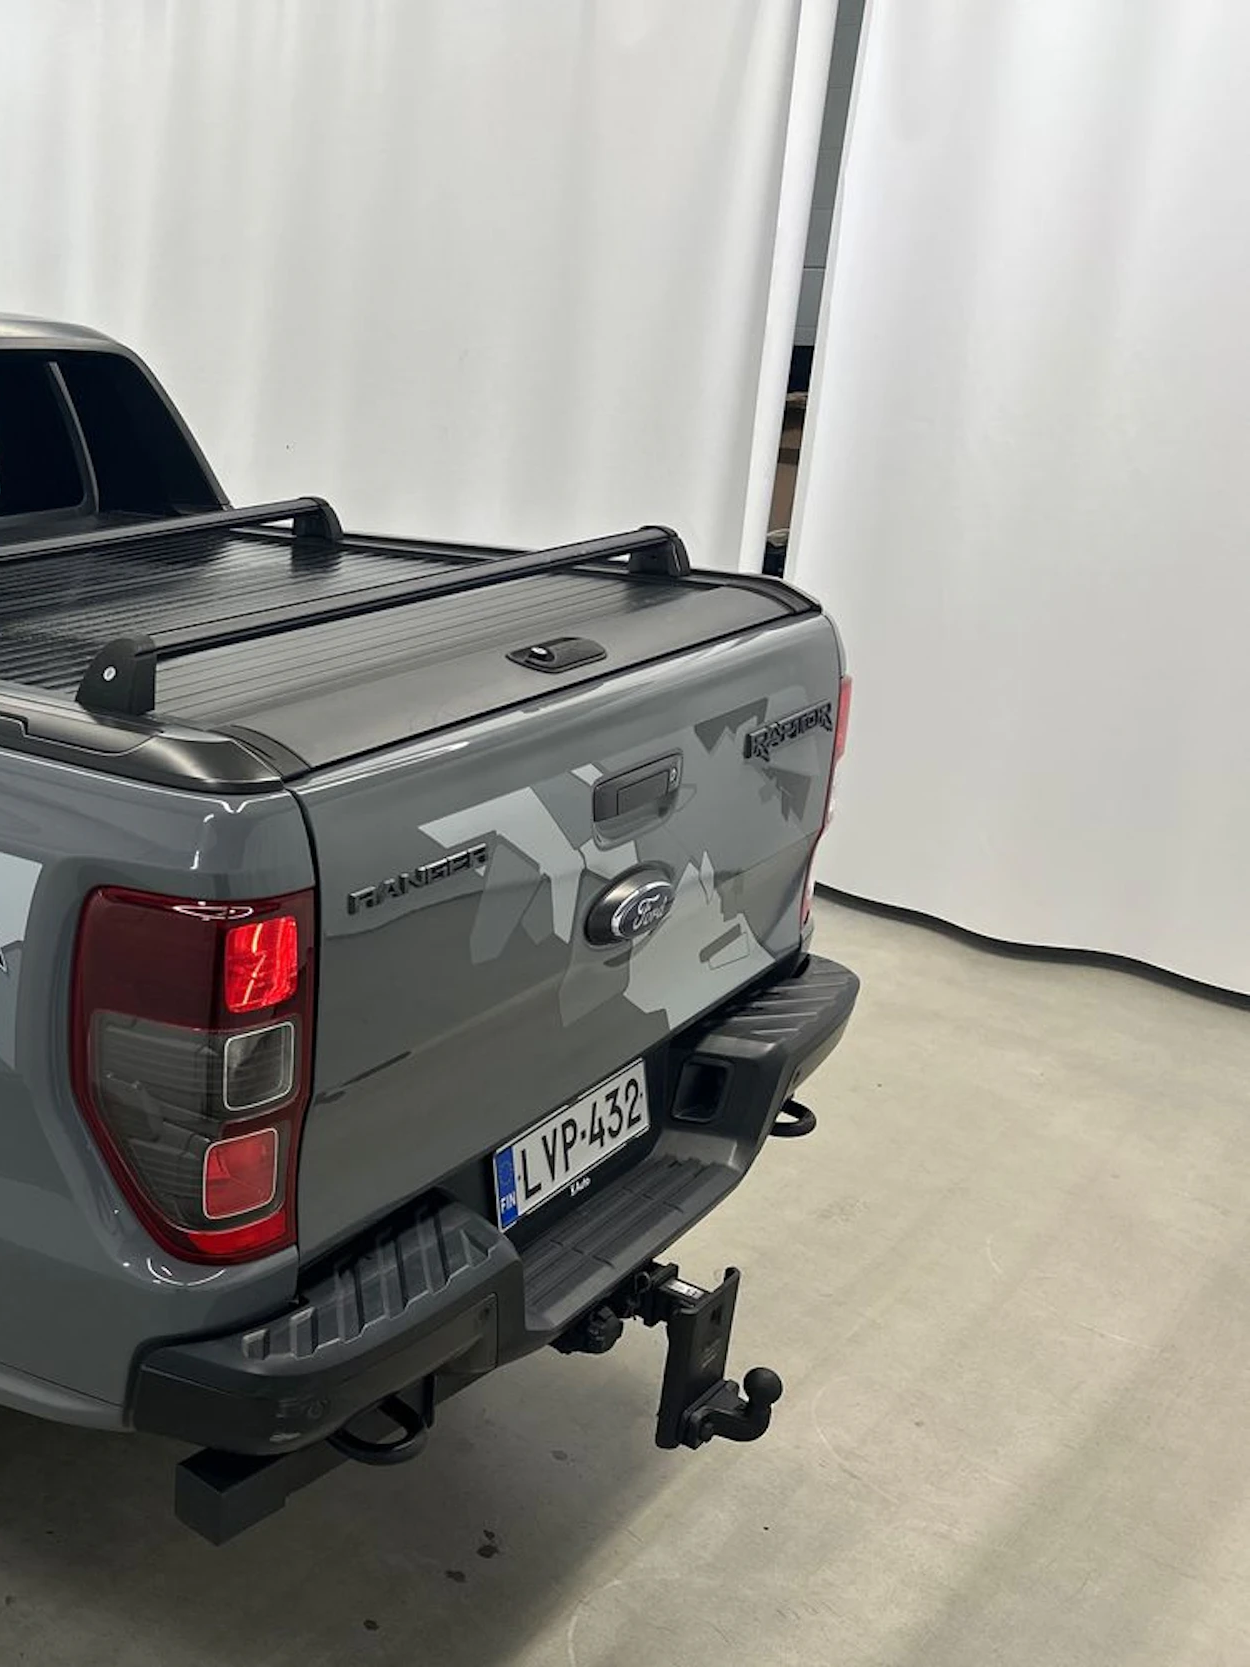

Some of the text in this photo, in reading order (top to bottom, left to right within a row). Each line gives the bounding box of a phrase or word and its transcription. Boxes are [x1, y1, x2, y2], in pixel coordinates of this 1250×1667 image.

[744, 699, 833, 762] RAPTOR
[348, 842, 488, 915] RANGER
[632, 893, 668, 931] Ford
[521, 1078, 642, 1201] LVP-432
[500, 1190, 517, 1214] FIN
